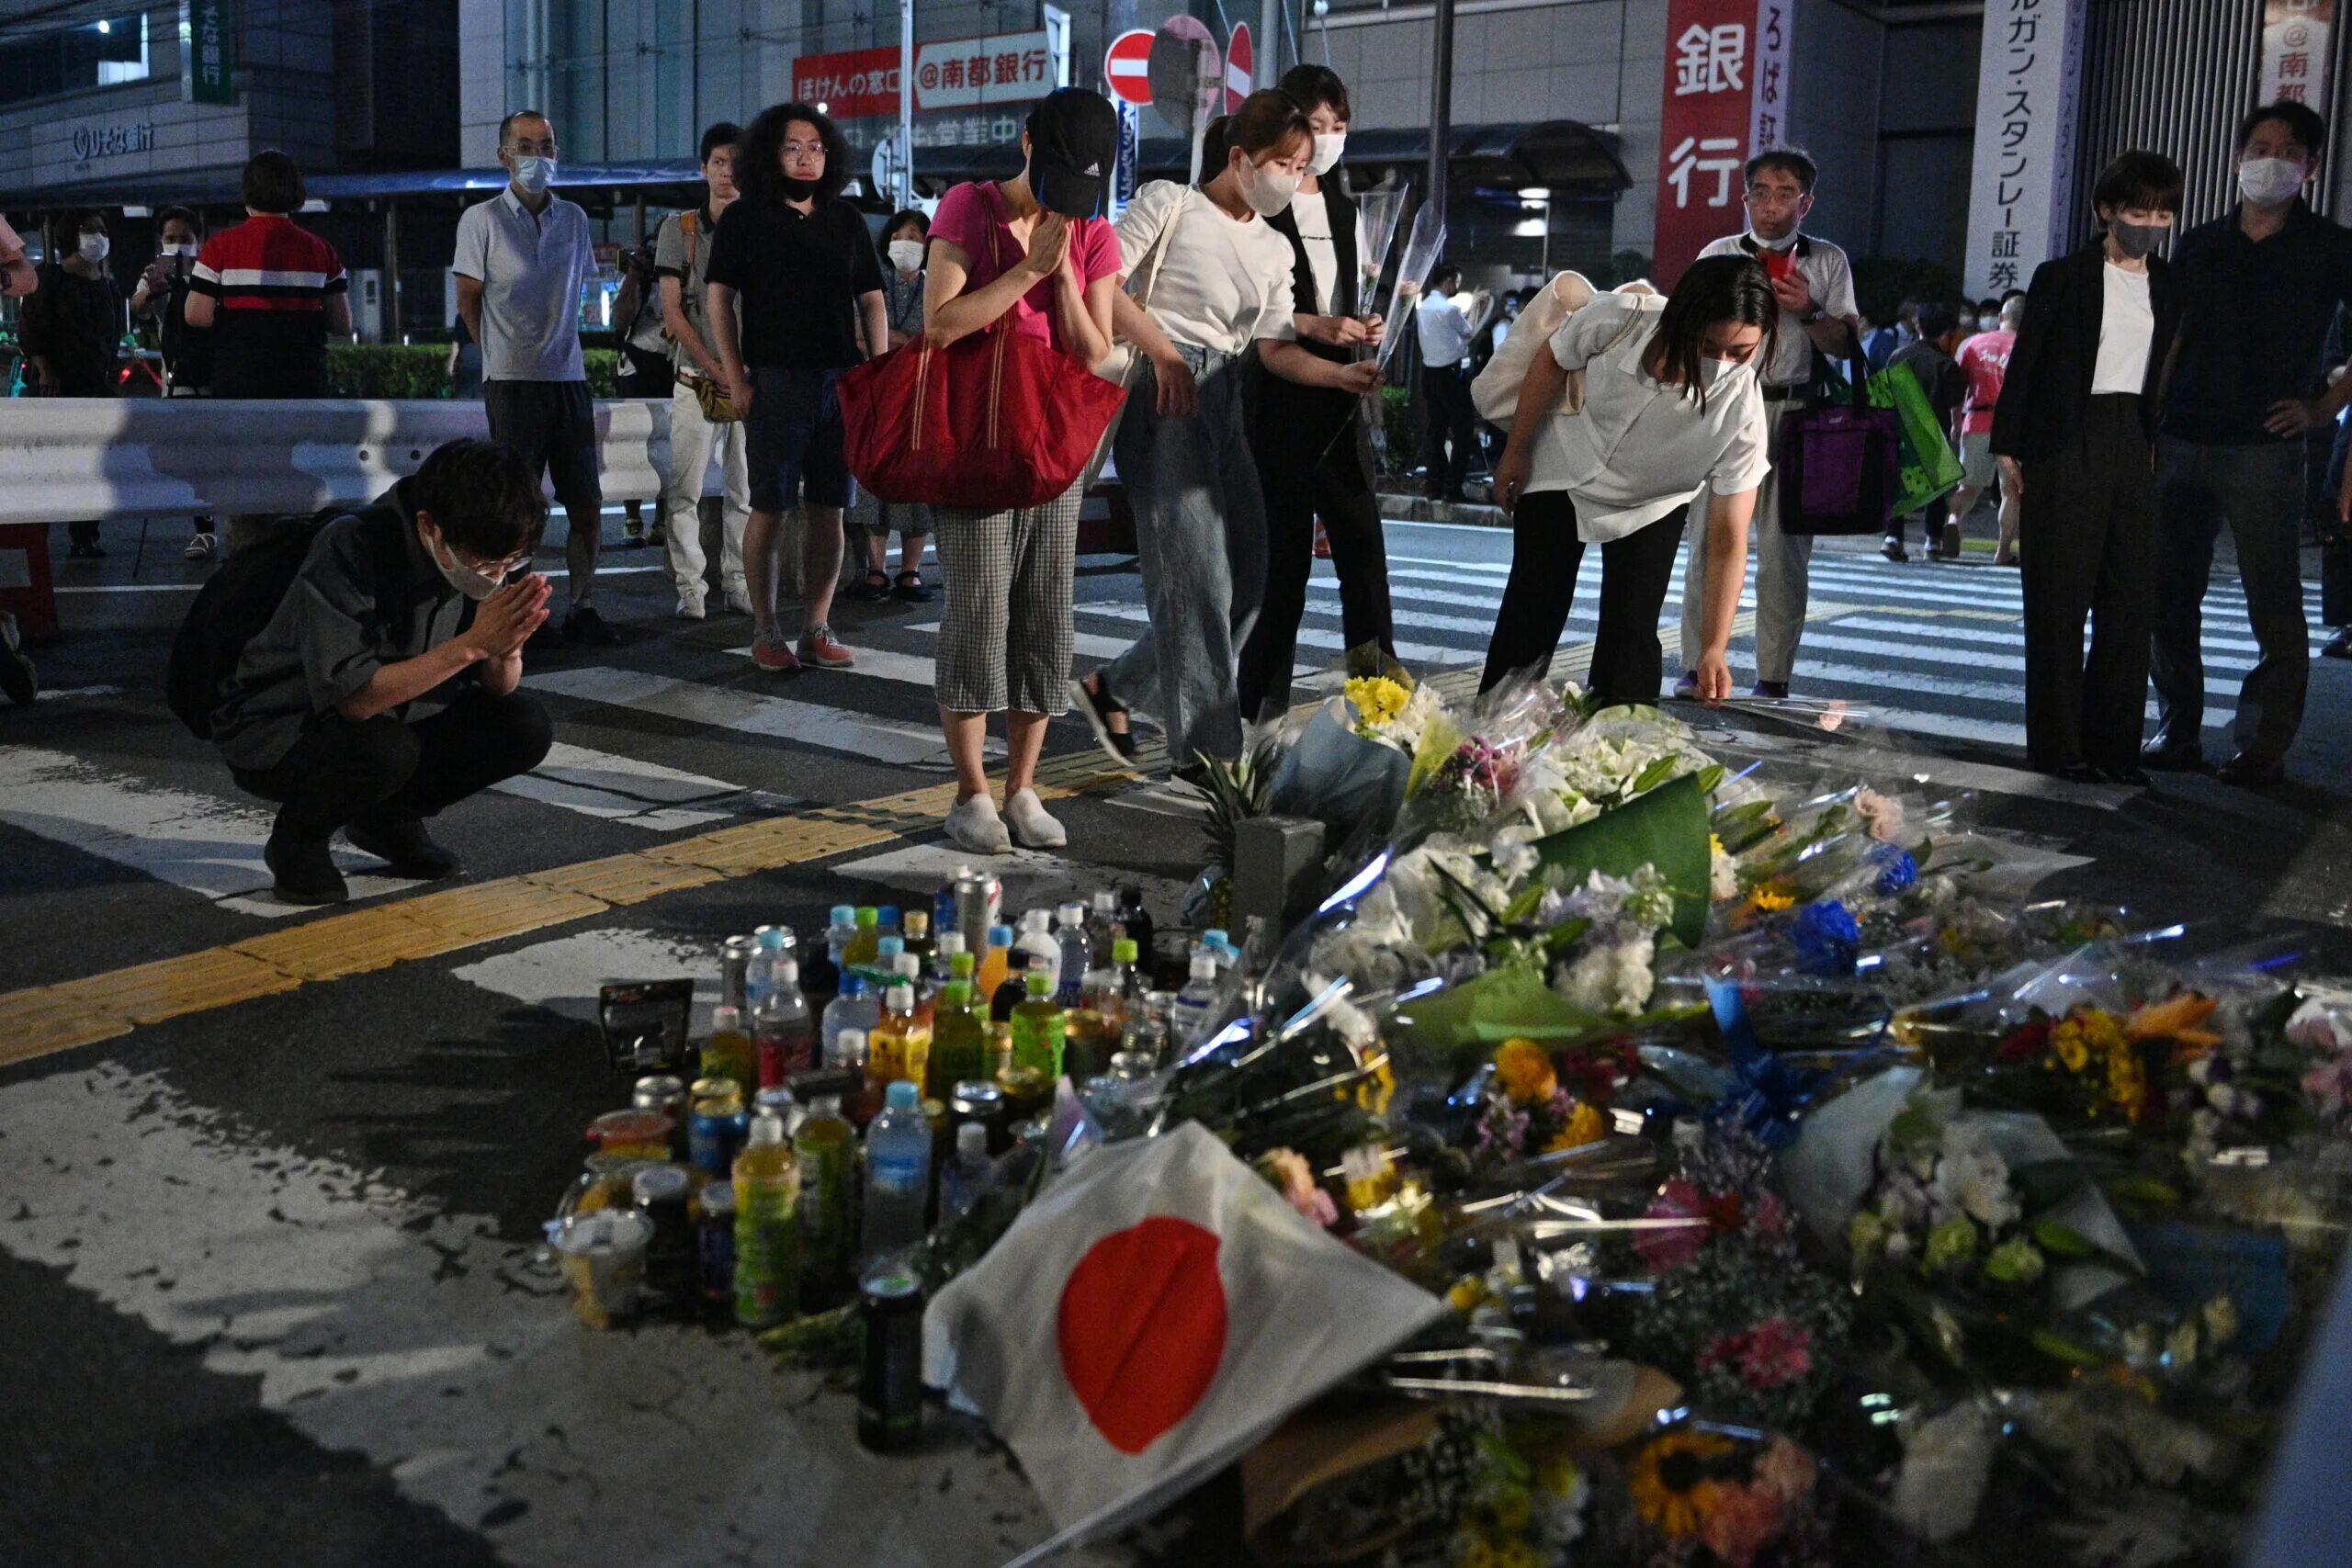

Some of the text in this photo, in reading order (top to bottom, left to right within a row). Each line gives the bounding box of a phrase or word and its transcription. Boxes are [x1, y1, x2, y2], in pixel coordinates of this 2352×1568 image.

[921, 50, 1046, 90] @南都銀行
[1667, 22, 1746, 209] 銀行
